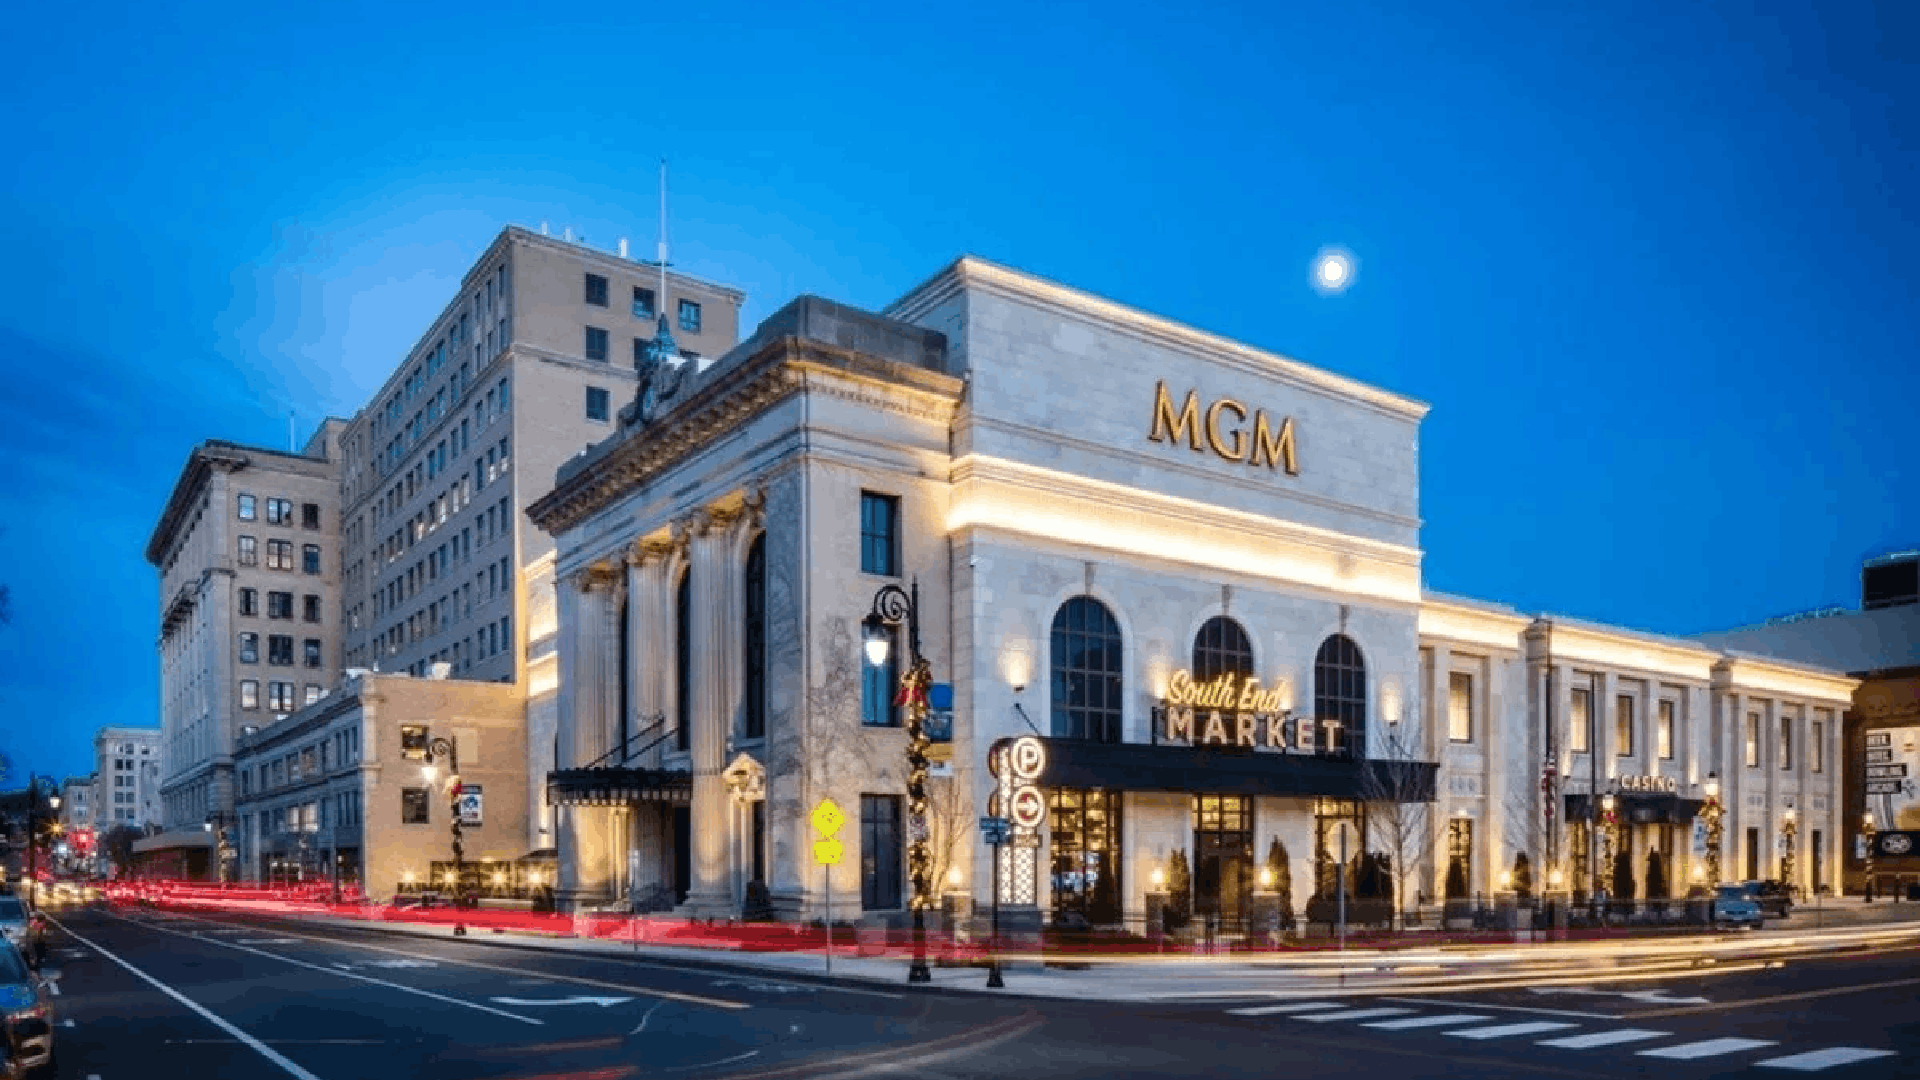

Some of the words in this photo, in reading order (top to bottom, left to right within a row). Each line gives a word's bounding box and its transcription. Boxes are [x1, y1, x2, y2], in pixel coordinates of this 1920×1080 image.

[1147, 380, 1299, 477] MGM
[1168, 669, 1236, 708] South
[1238, 676, 1291, 713] End
[1167, 707, 1343, 753] MARKET
[1020, 745, 1039, 773] P
[1621, 774, 1676, 792] CASINO
